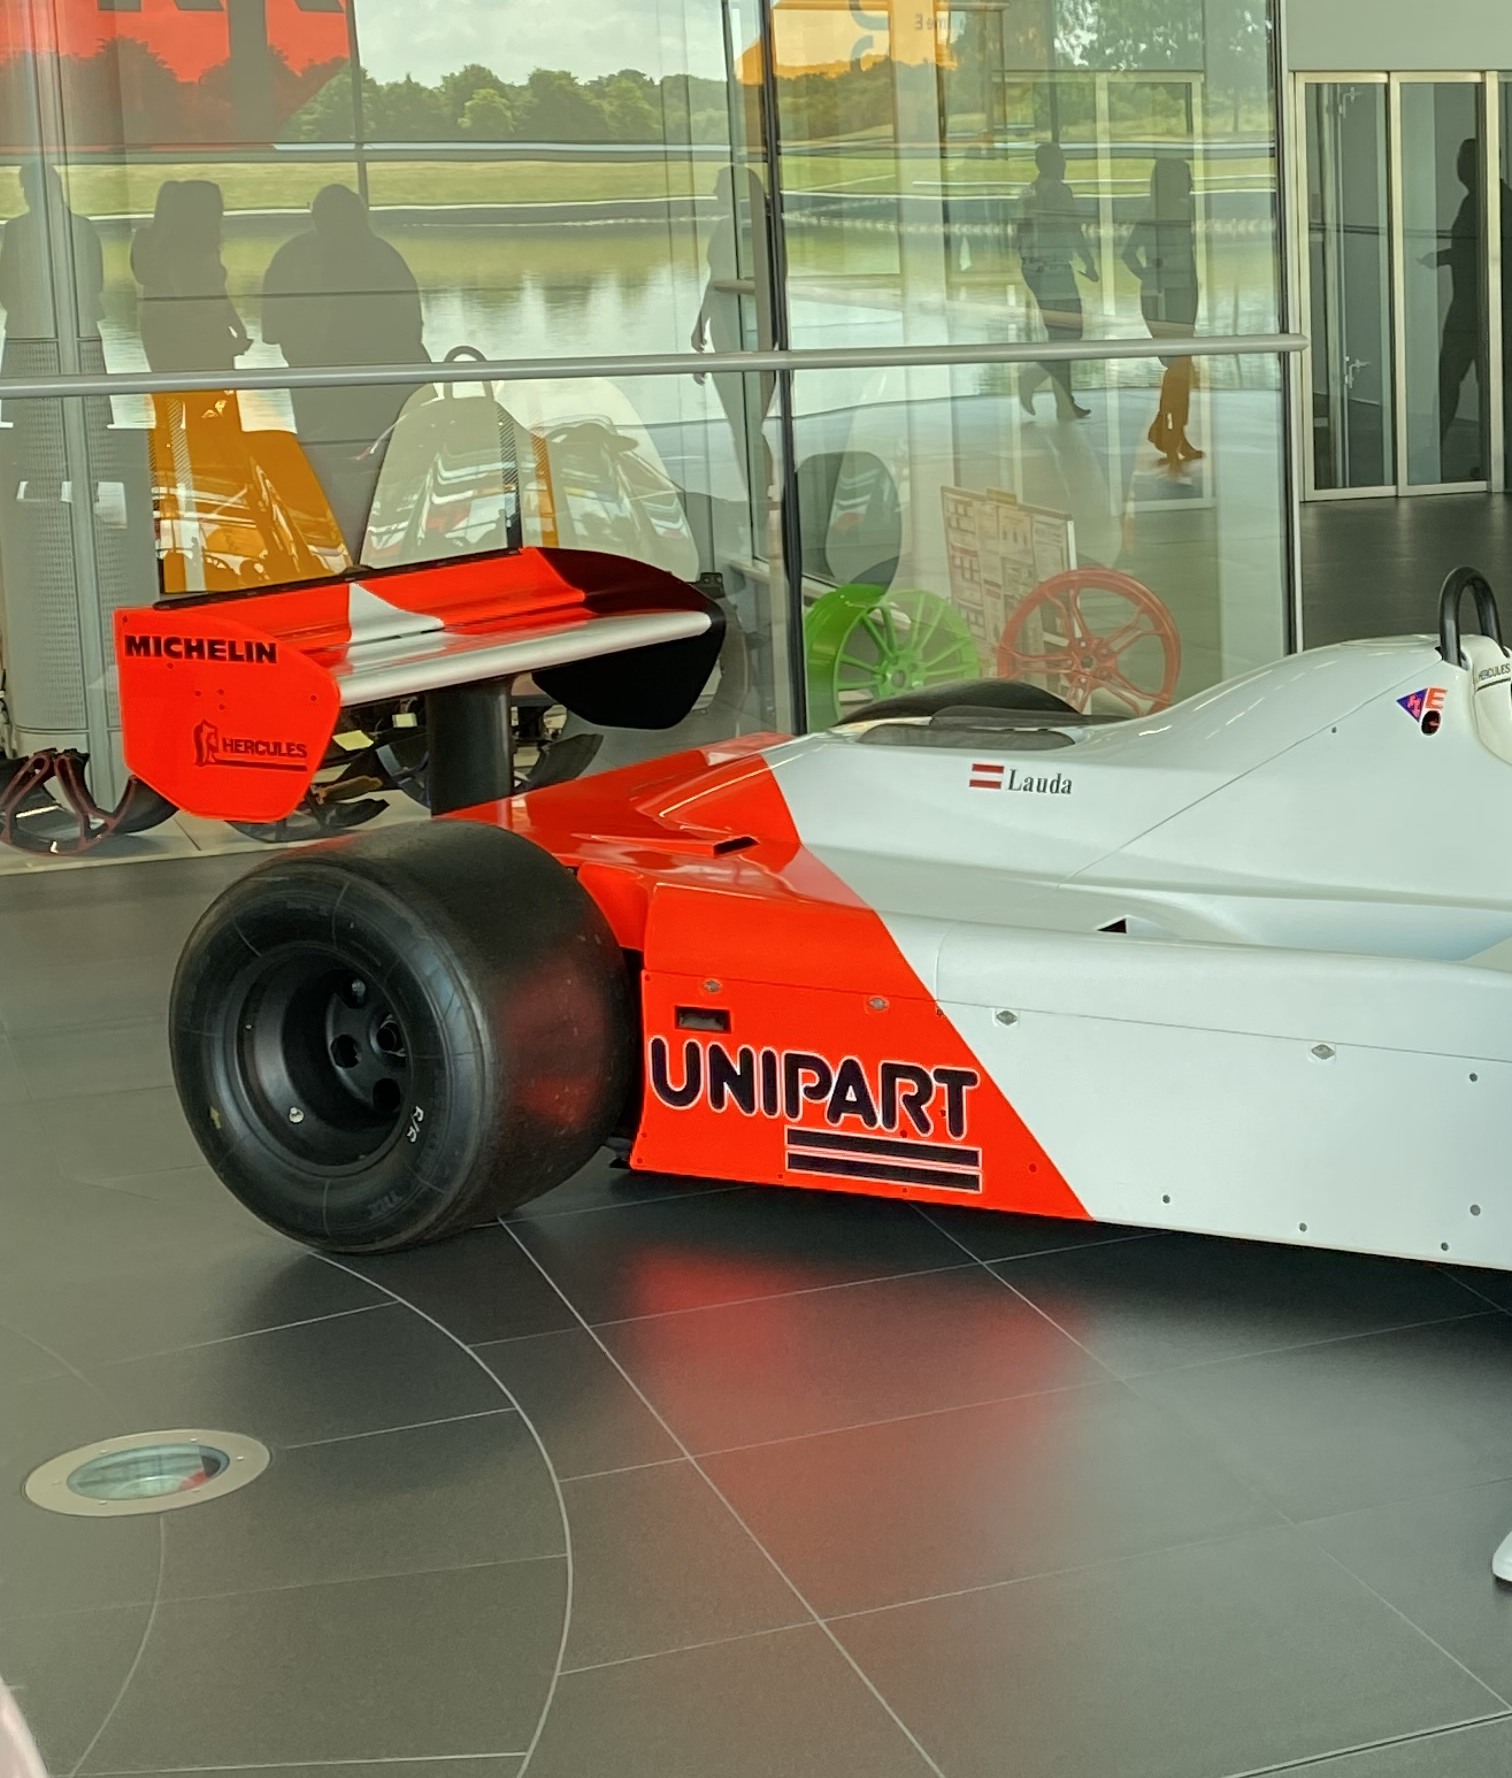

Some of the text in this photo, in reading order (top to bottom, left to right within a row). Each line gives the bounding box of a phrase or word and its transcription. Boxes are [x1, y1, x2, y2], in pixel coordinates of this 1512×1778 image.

[124, 635, 278, 664] MICHELIN
[221, 737, 308, 758] HERCULES
[1007, 768, 1072, 794] Lauda
[650, 1035, 979, 1140] UNIPART
